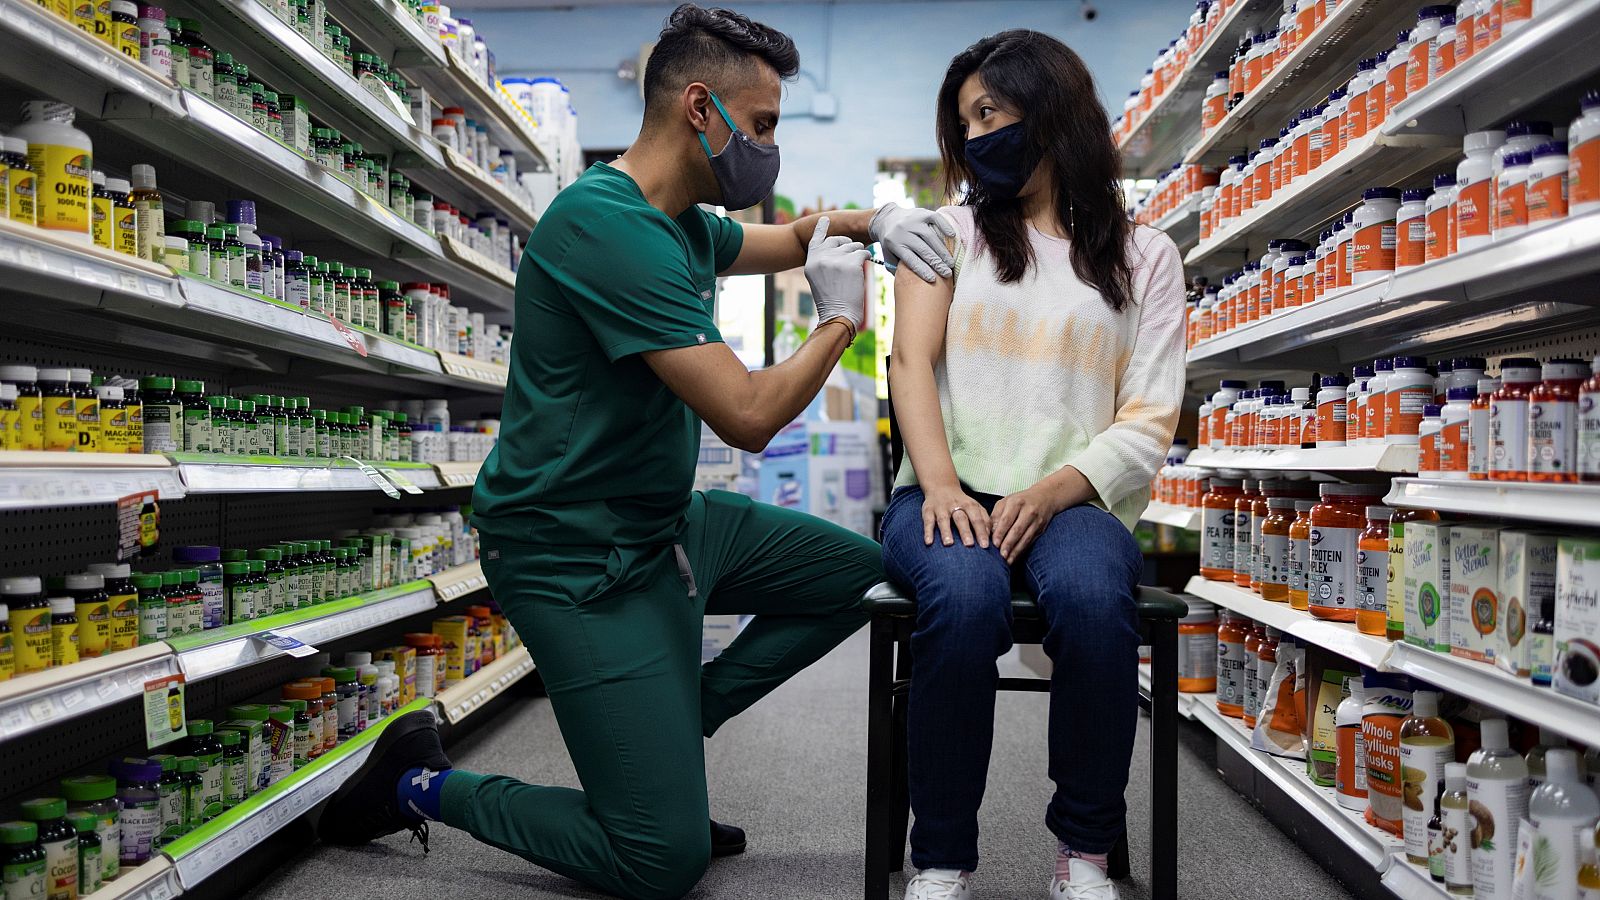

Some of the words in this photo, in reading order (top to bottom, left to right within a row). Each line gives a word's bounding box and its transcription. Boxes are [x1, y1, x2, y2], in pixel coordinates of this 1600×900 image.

[79, 431, 96, 448] D3
[1206, 526, 1220, 538] PEA
[1455, 543, 1479, 562] Better
[1462, 555, 1489, 576] Stevia
[1361, 720, 1393, 741] Whole
[1380, 773, 1392, 781] Fiber
